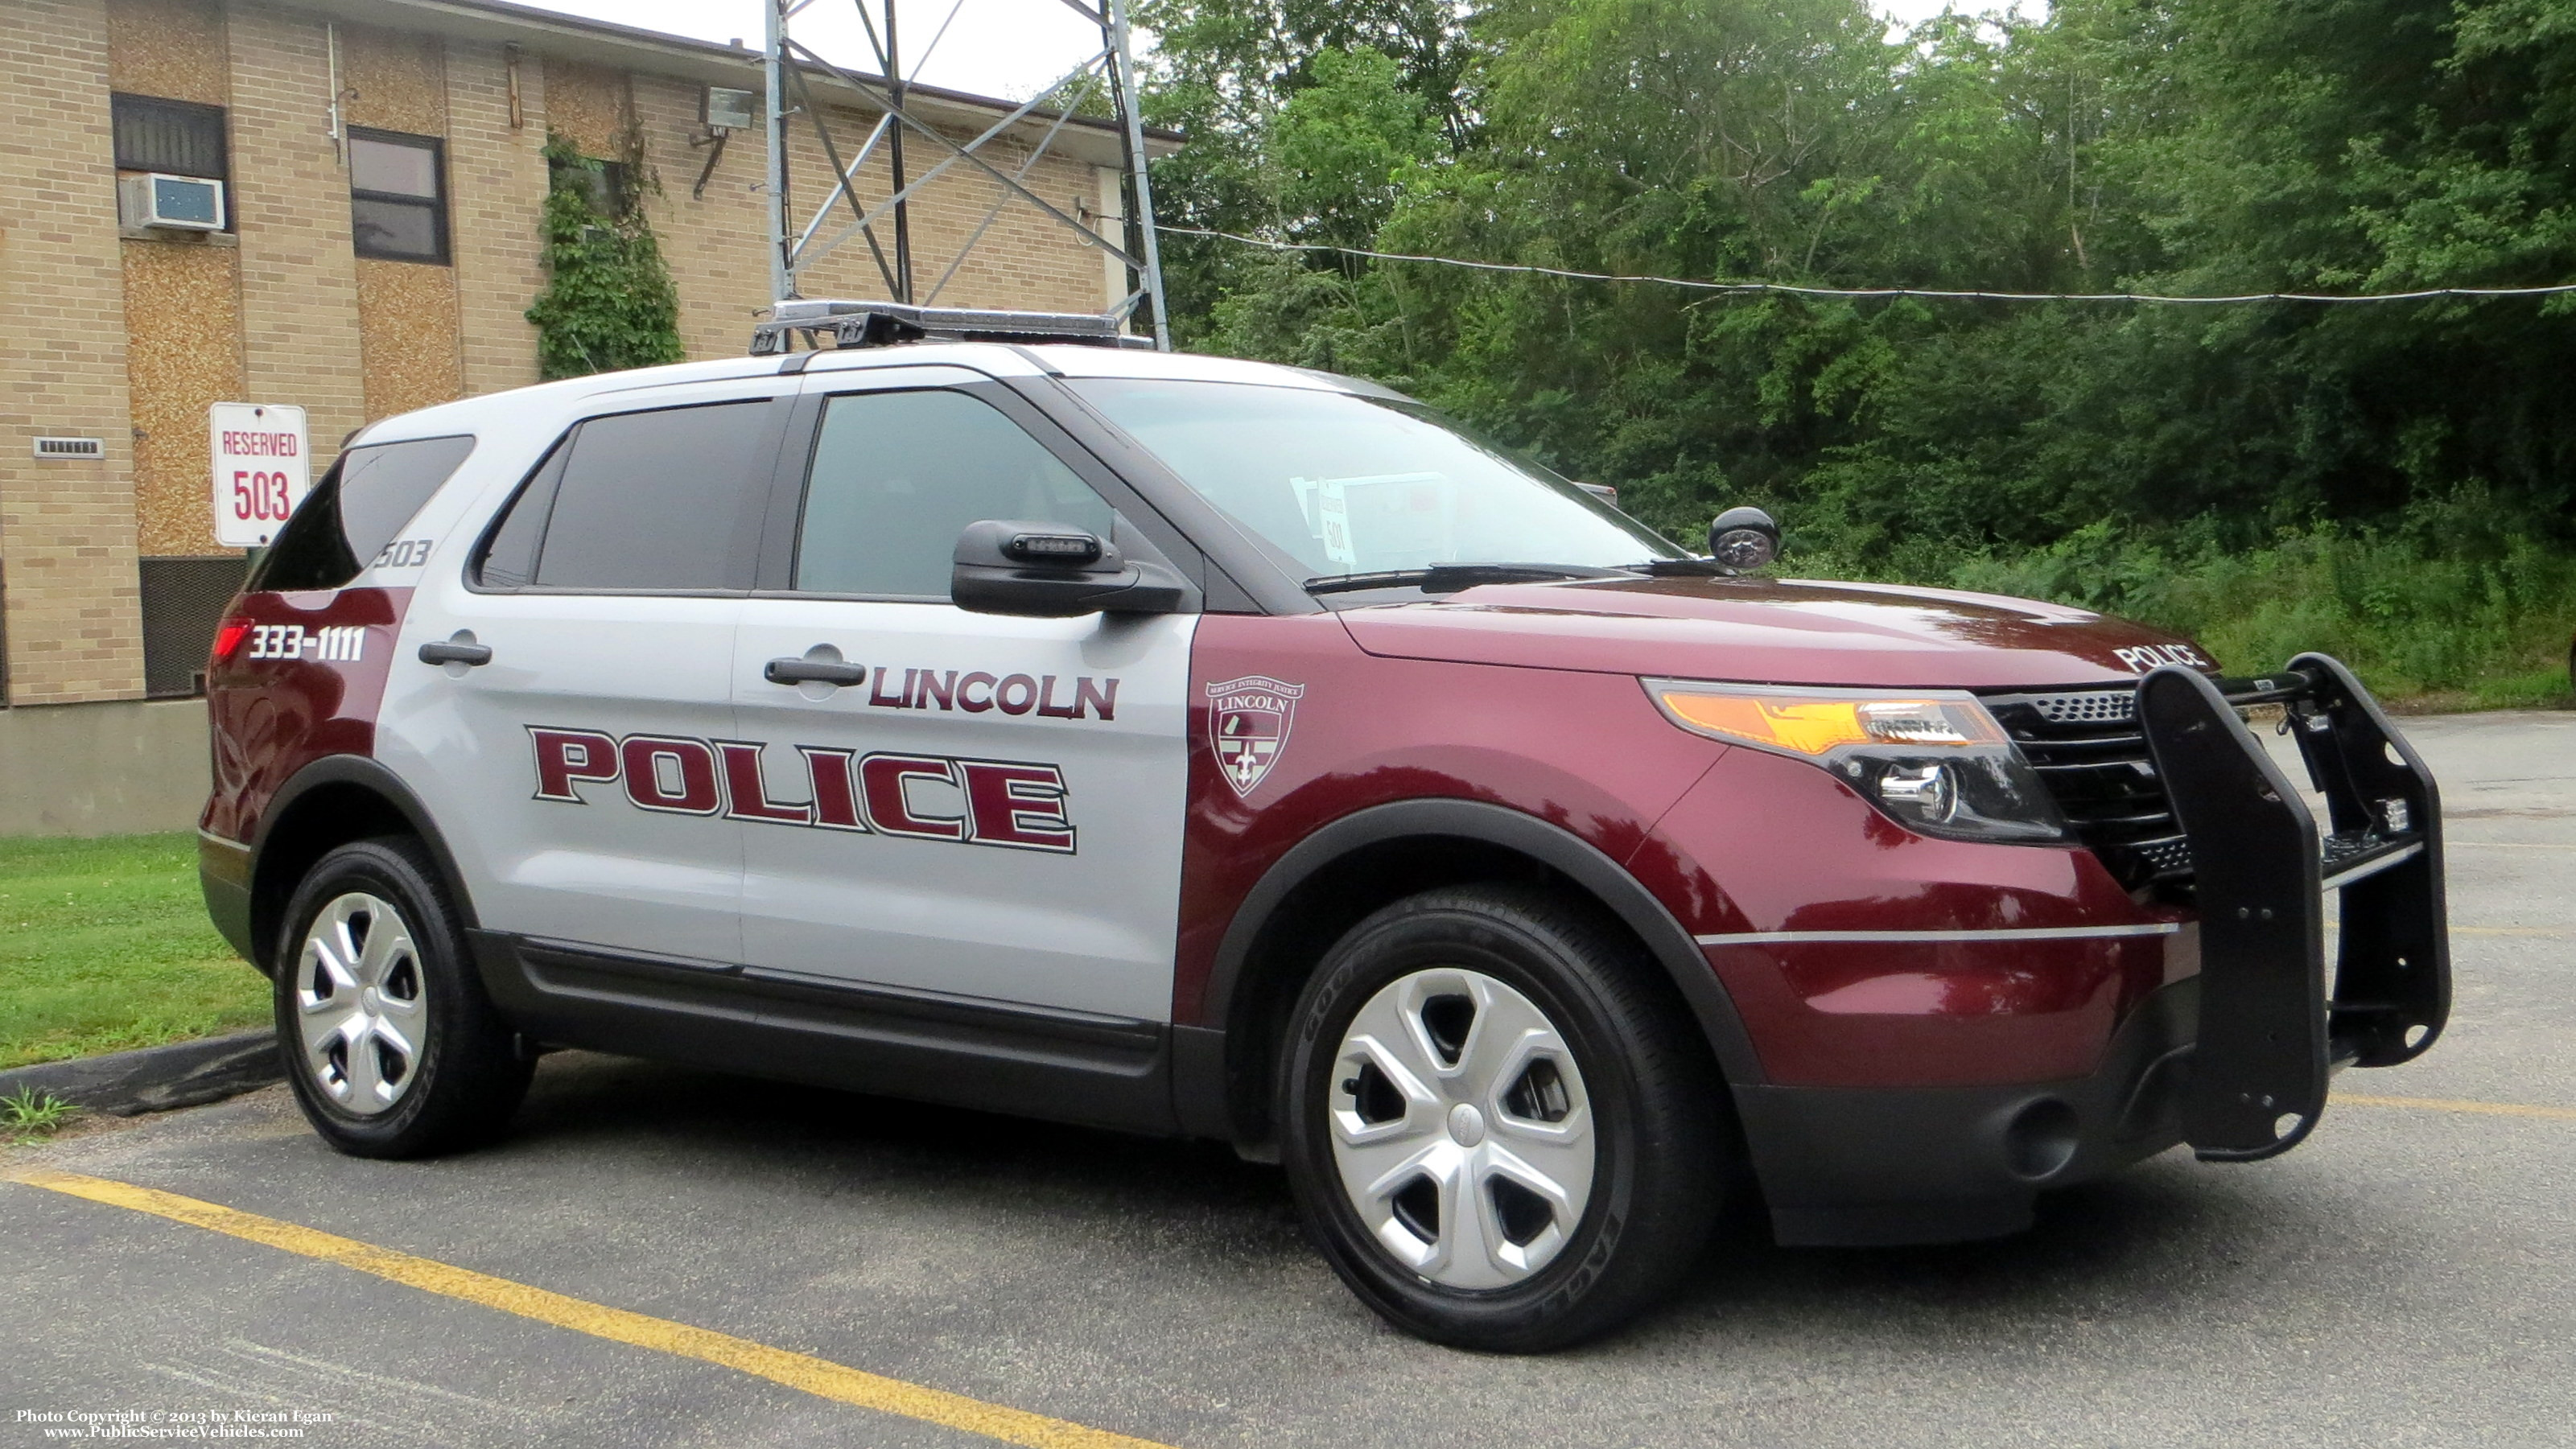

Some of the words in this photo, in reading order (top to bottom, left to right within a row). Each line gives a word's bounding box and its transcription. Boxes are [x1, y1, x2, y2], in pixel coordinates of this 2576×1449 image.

[223, 430, 298, 457] RESERVED
[233, 471, 291, 521] 503
[373, 539, 434, 569] 503
[249, 625, 366, 661] 333-1111
[2112, 644, 2207, 673] POLICE
[869, 666, 1121, 722] LINCOLN
[1218, 695, 1288, 713] LINCOLN
[523, 724, 1078, 855] POLICE
